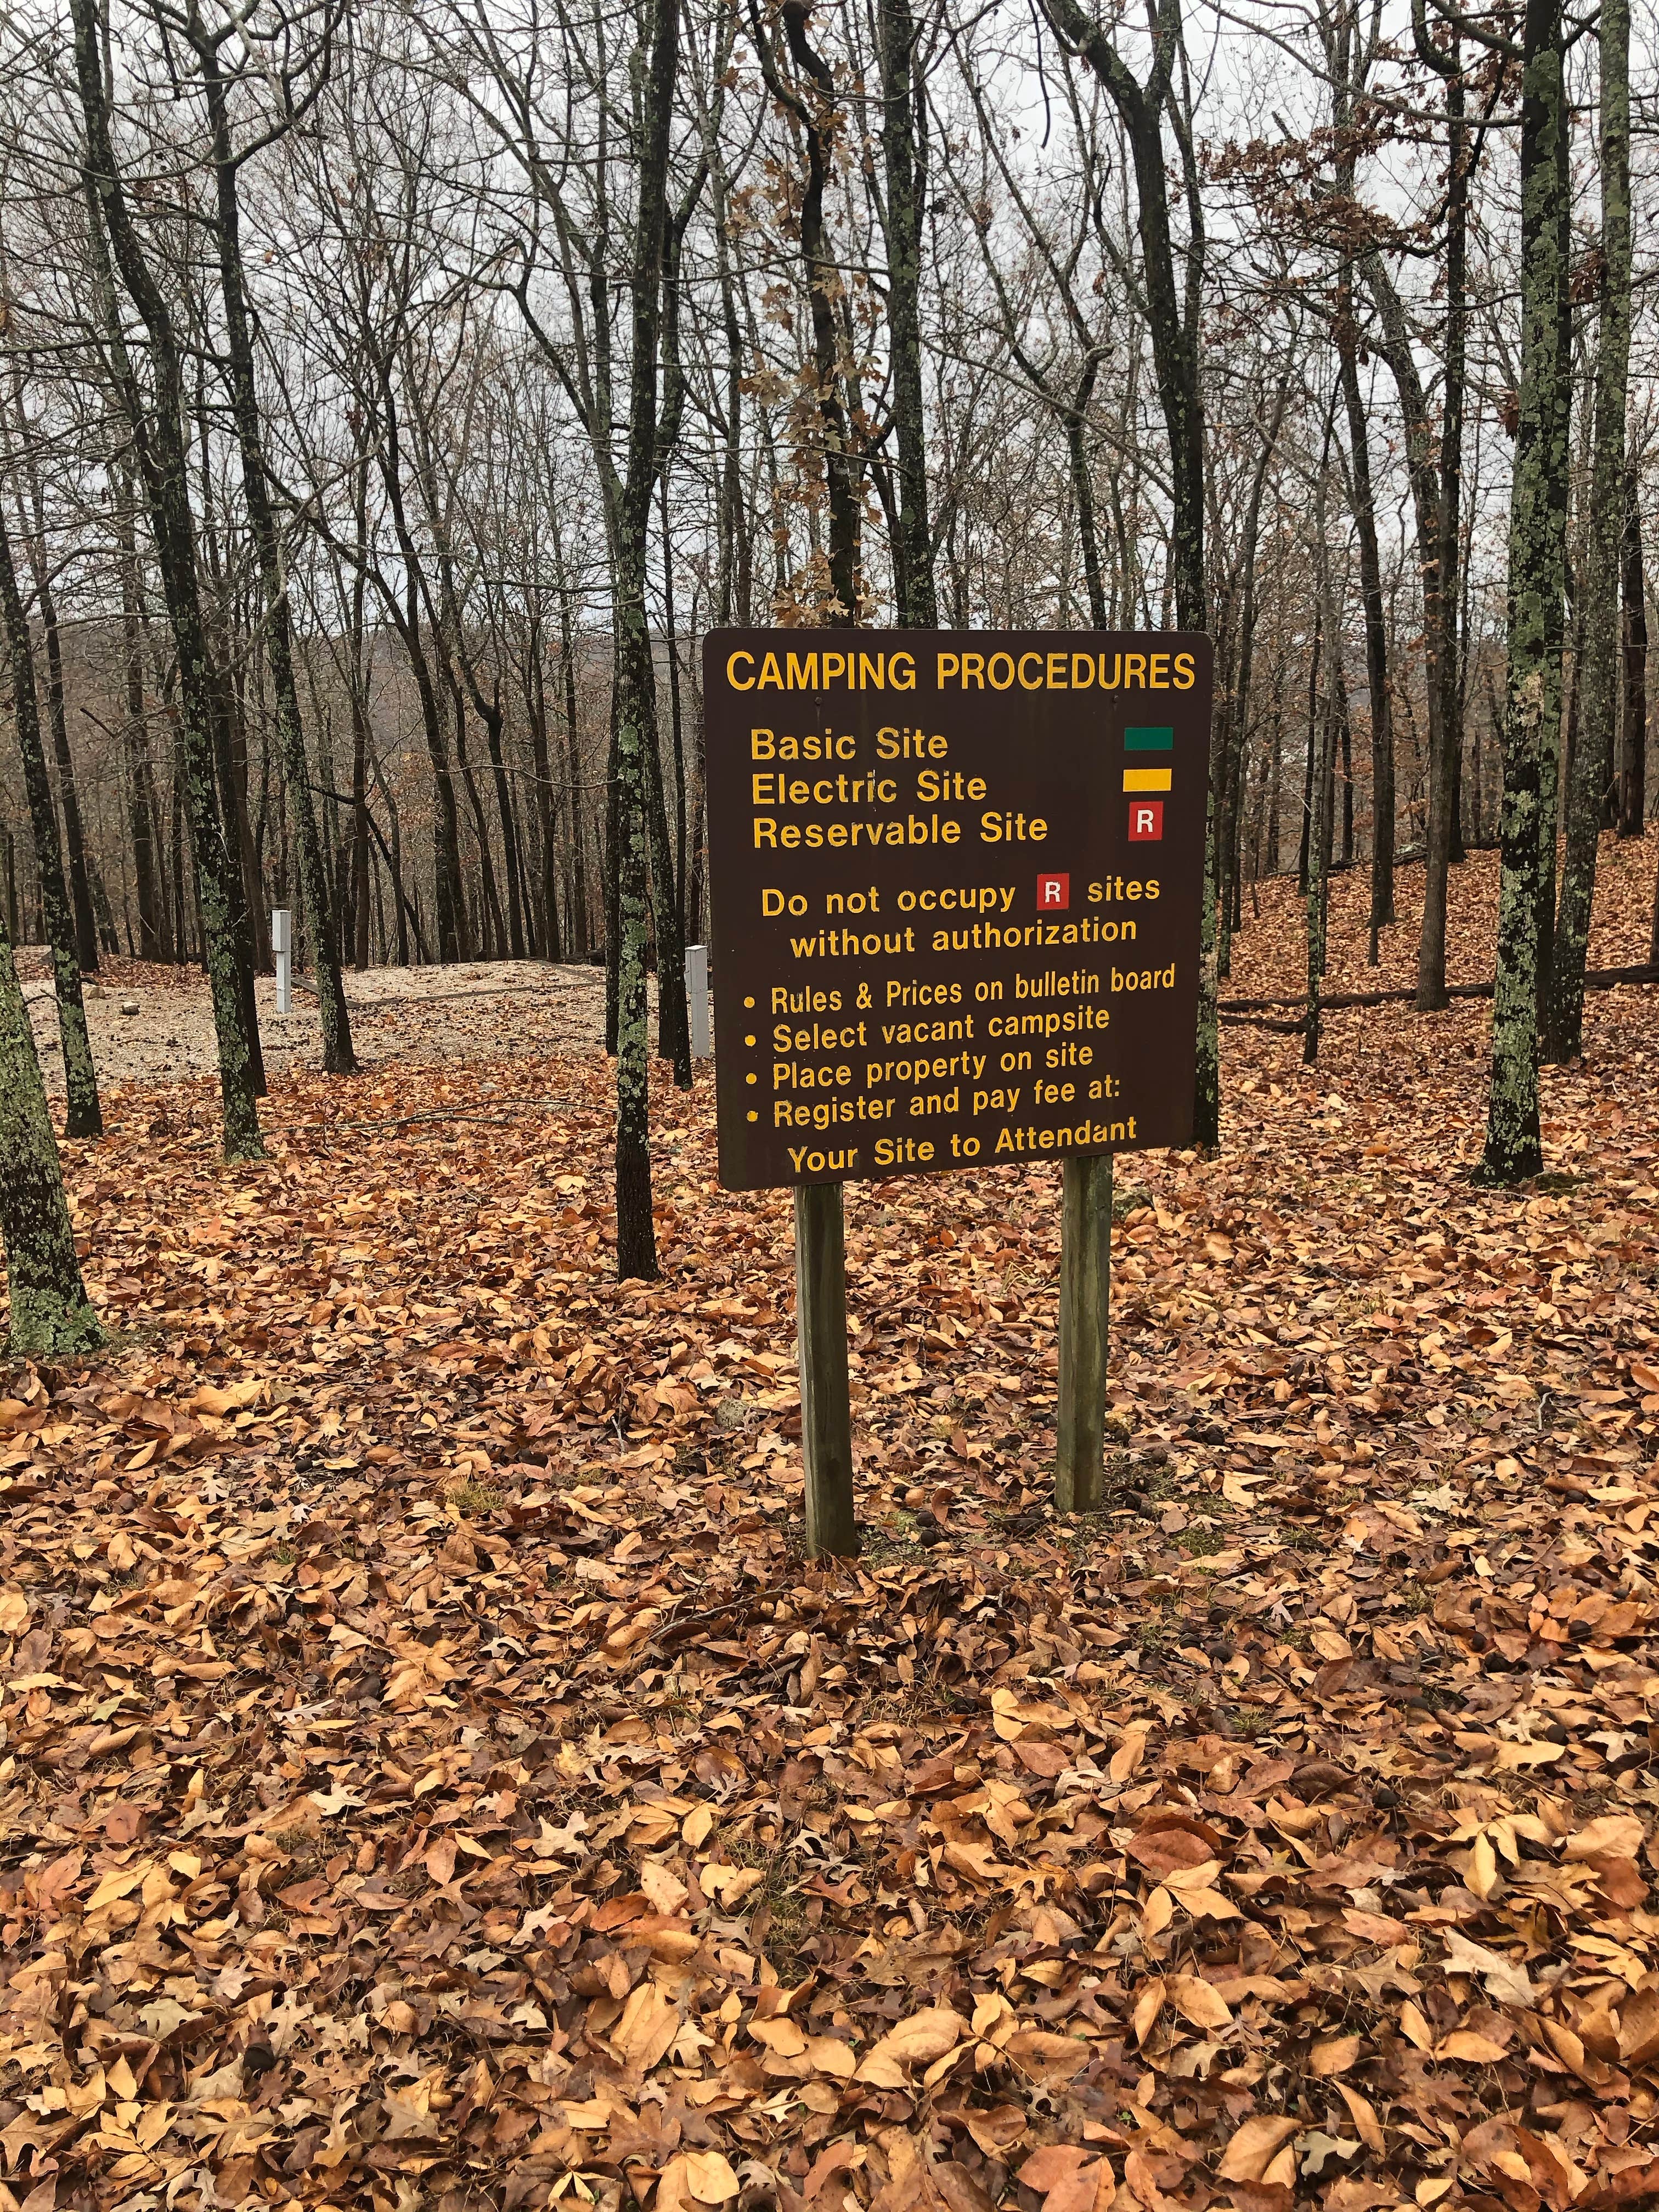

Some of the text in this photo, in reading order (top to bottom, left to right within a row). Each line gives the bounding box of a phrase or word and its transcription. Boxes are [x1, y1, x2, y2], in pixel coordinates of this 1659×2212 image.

[726, 651, 1195, 691] CAMPING PROCEDURES
[751, 727, 948, 760] Basic Site
[752, 769, 987, 805] Electric Site
[753, 811, 1048, 848] Reservable Site
[1137, 809, 1154, 833] R
[762, 875, 1160, 916] Do not occupy R sites
[789, 916, 1136, 958] without authorization
[771, 963, 1175, 1014] Rules & Prices on bulletin board
[772, 1005, 1110, 1053] Select vacant campsite
[772, 1041, 1093, 1090] Place property on site
[774, 1074, 1120, 1130] Register and pay fee at:
[787, 1116, 1137, 1173] Your Site to Attendant
